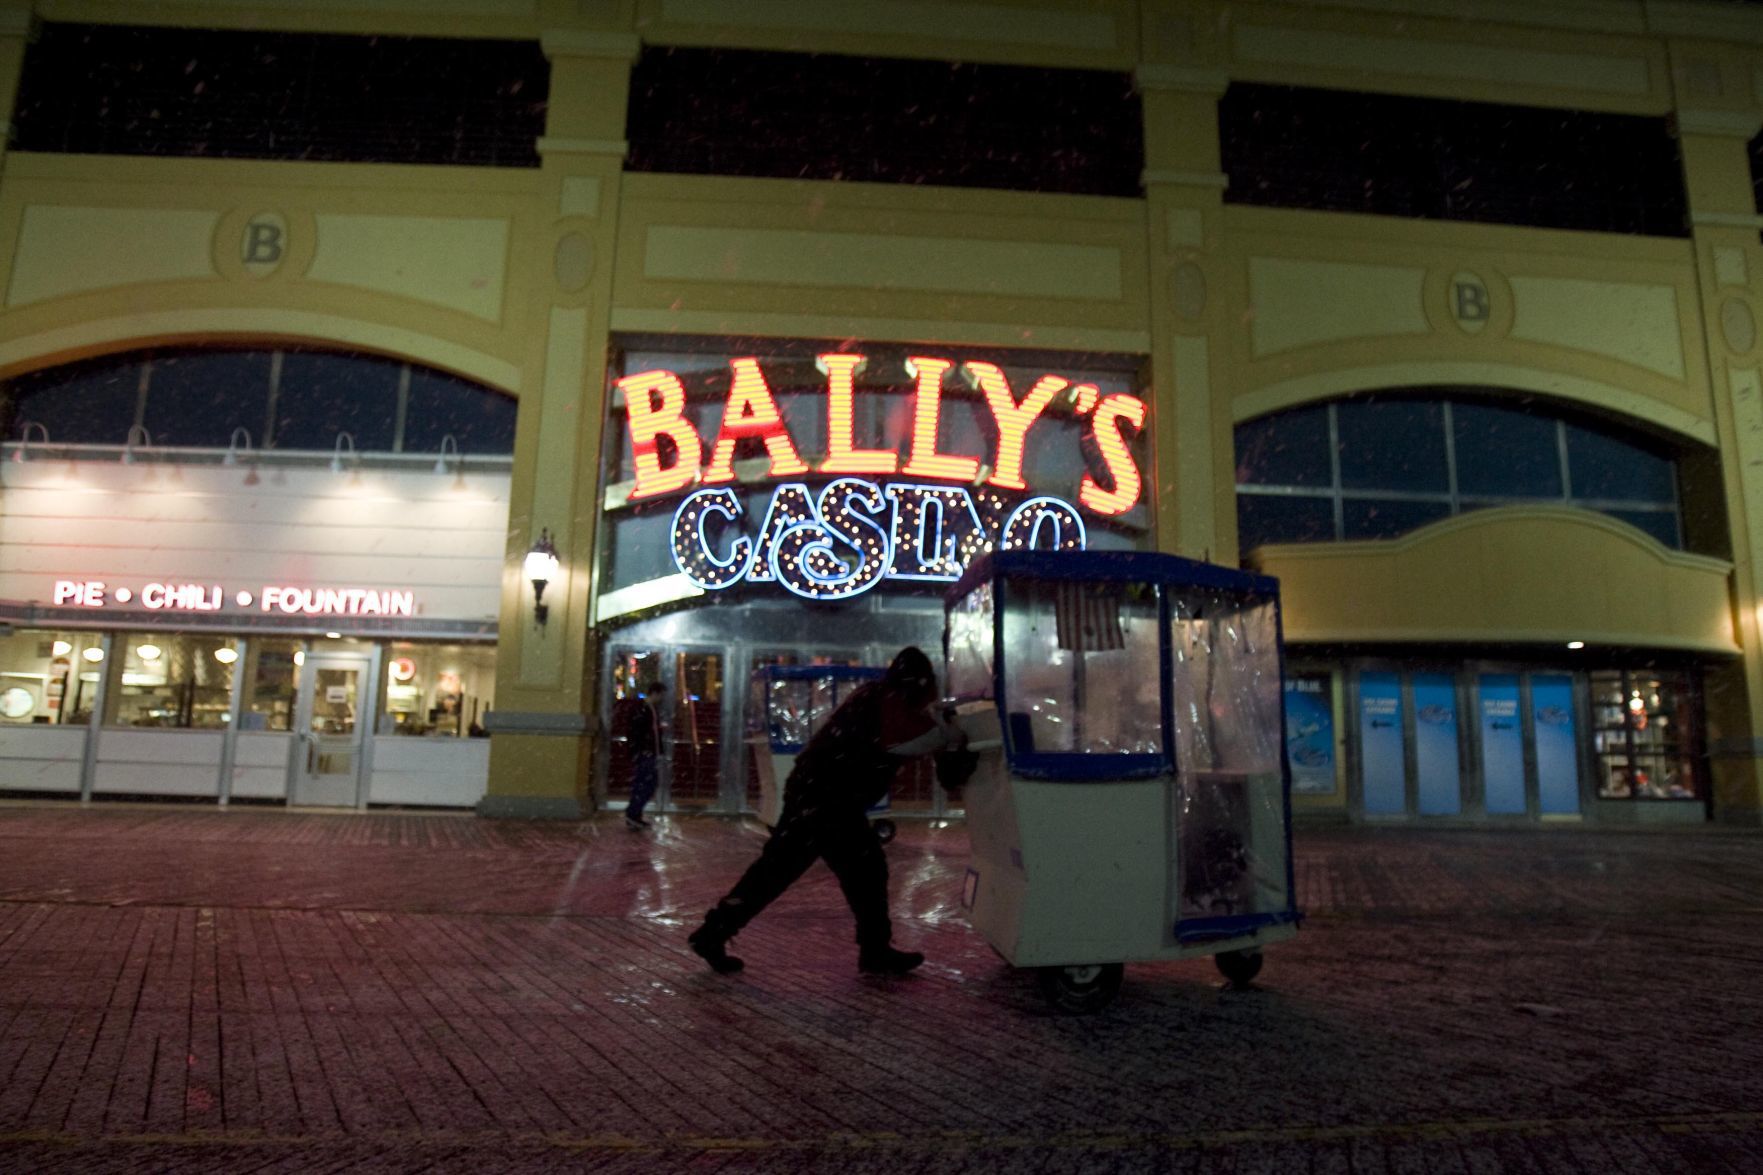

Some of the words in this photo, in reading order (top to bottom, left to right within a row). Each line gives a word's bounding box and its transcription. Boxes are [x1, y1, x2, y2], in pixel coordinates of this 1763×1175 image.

[242, 222, 282, 264] B
[1455, 281, 1489, 321] B
[616, 352, 1148, 517] BALLY'S
[53, 579, 107, 607] PIE
[141, 582, 223, 610] CHILI
[261, 586, 414, 616] FOUNTAIN
